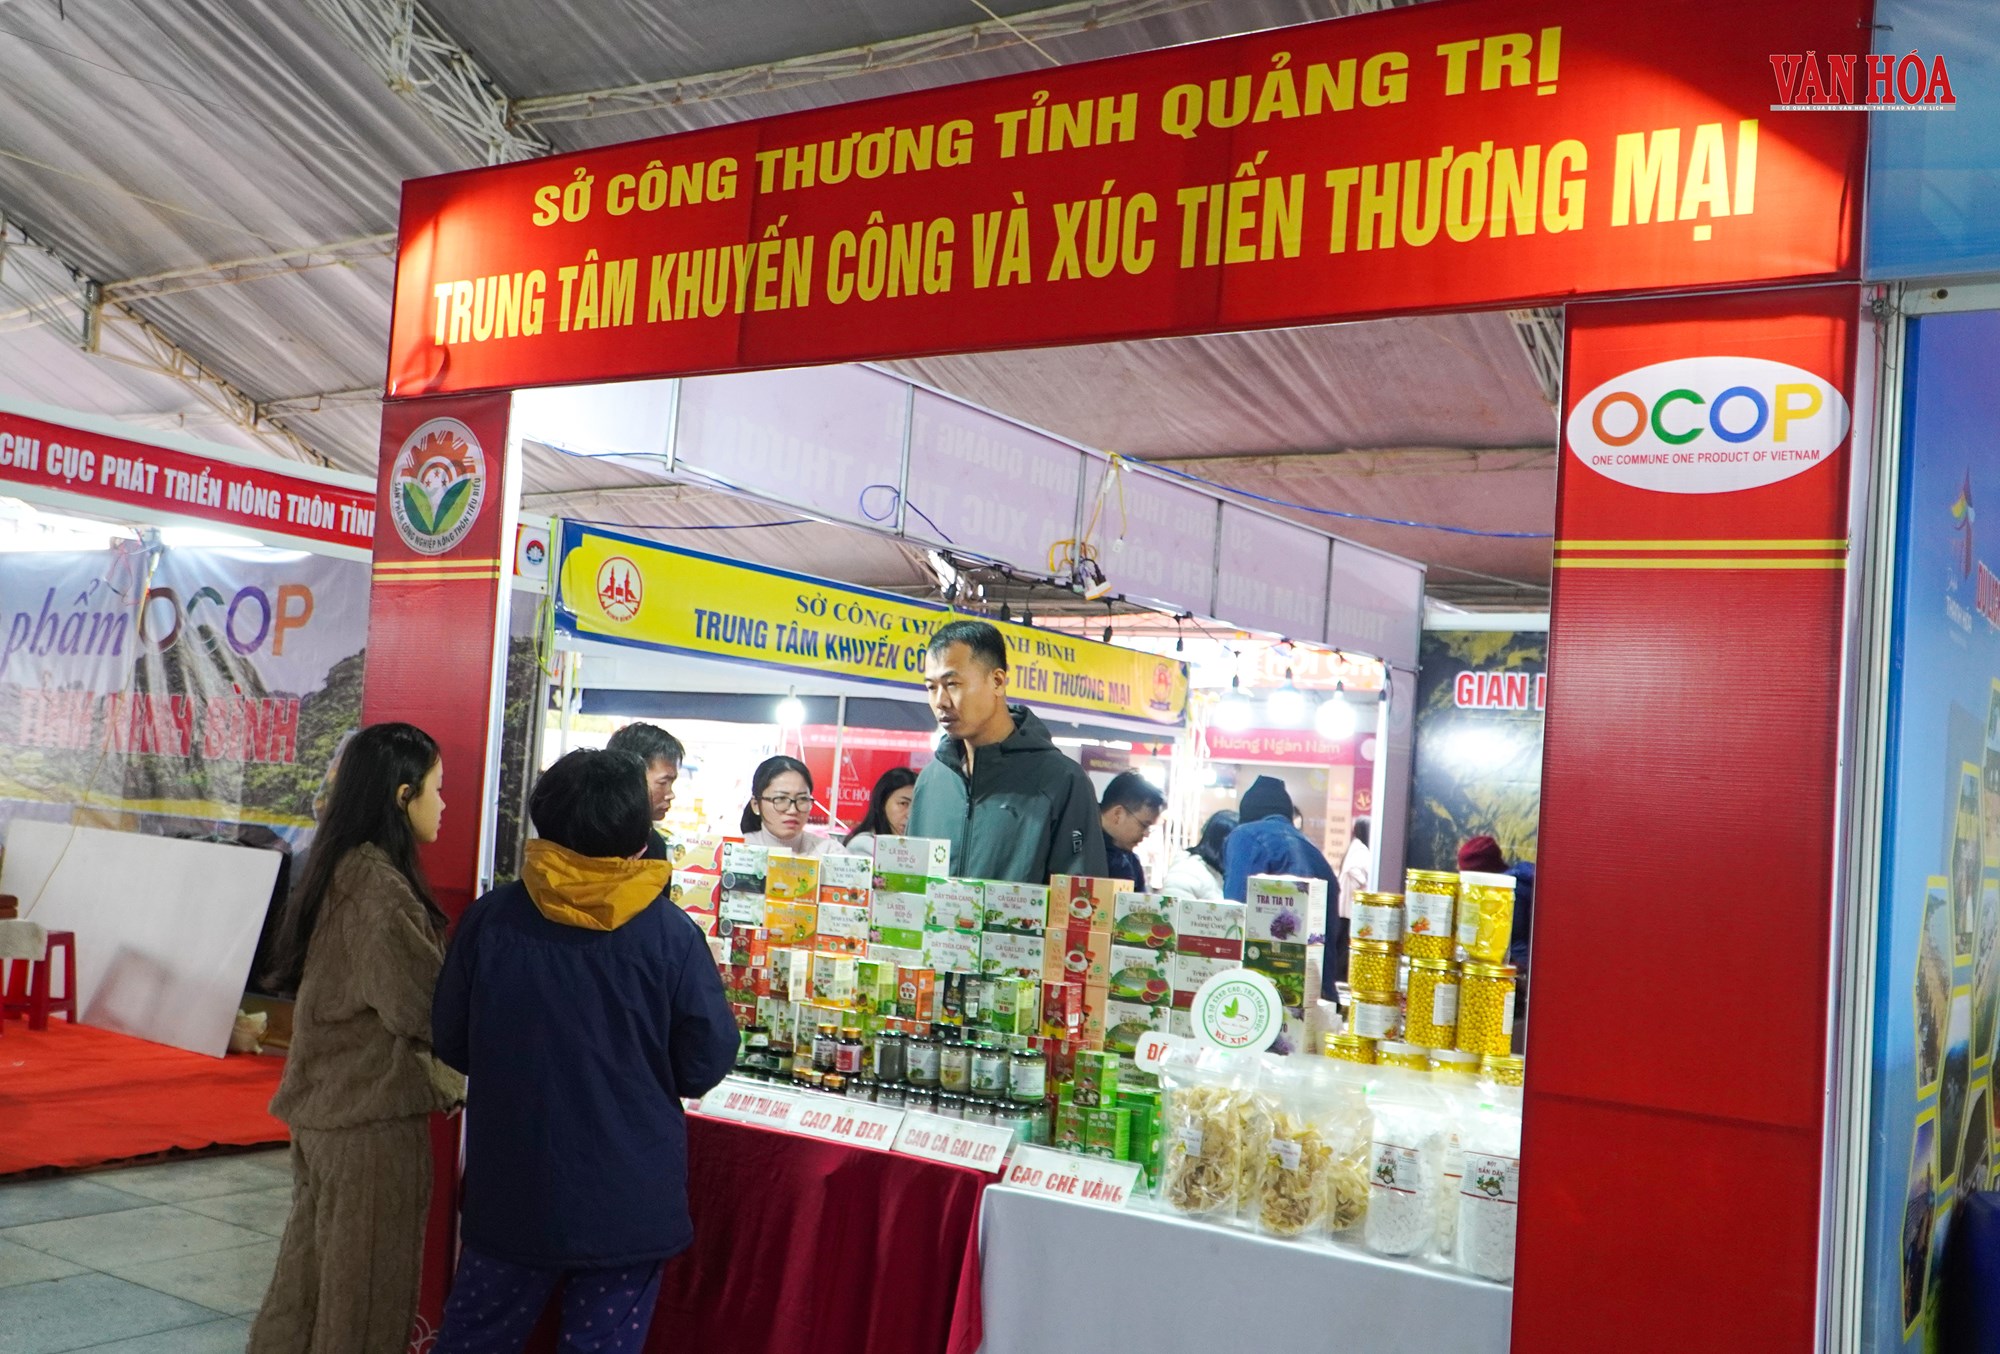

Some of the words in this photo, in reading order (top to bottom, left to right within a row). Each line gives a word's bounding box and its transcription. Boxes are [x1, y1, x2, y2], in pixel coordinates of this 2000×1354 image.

[532, 167, 594, 227] SỞ
[606, 157, 738, 217] CÔNG
[755, 118, 973, 193] THƯƠNG
[994, 90, 1138, 159] TỈNH
[1160, 52, 1409, 139] QUẢNG
[1435, 26, 1561, 96] TRỊ
[433, 269, 546, 346] TRUNG
[558, 249, 638, 333] TÂM
[647, 215, 814, 323] KHUYẾN
[825, 210, 956, 304] CÔNG
[972, 191, 1031, 289] VÀ
[1047, 180, 1157, 282] XÚC
[1176, 151, 1305, 269] TIẾN
[1325, 140, 1588, 254] THƯƠNG
[1610, 119, 1758, 242] MẠI
[1592, 383, 1823, 447] OCOP
[0, 432, 40, 471] CHI
[46, 443, 96, 484] CỤC
[100, 456, 159, 495] PHÁT
[164, 466, 222, 508] TRIỂN
[226, 480, 281, 520] NÔNG
[286, 494, 336, 530] THÔN
[1592, 455, 1613, 466] ONE
[1616, 453, 1669, 465] COMMUNE
[1672, 453, 1694, 464] ONE
[1698, 451, 1749, 464] PRODUCT
[1753, 451, 1767, 462] OF
[1770, 450, 1820, 461] VIETNAM
[141, 585, 314, 656] OCOP
[796, 592, 828, 617] SỞ
[833, 602, 893, 631] CÔNG
[900, 616, 939, 637] THƯ
[1036, 638, 1076, 663] BÌNH
[694, 609, 768, 649] TRUNG
[776, 620, 819, 658] TÂM
[825, 634, 900, 670] KHUYẾN
[904, 643, 926, 674] CÔ
[1016, 661, 1048, 692] TIẾN
[1053, 671, 1104, 701] THƯƠNG
[1109, 681, 1131, 710] MẠI
[1455, 671, 1529, 710] GIAN
[800, 1110, 832, 1130] CAO
[832, 1116, 853, 1138] XẠ
[855, 1121, 889, 1142] ĐEN
[904, 1128, 929, 1147] CAO
[931, 1133, 949, 1153] CÀ
[950, 1138, 973, 1159] GAI
[972, 1143, 997, 1164] LEO
[1010, 1165, 1043, 1187] CAO
[1046, 1173, 1079, 1196] CHÈ
[1082, 1177, 1123, 1204] VẰNG
